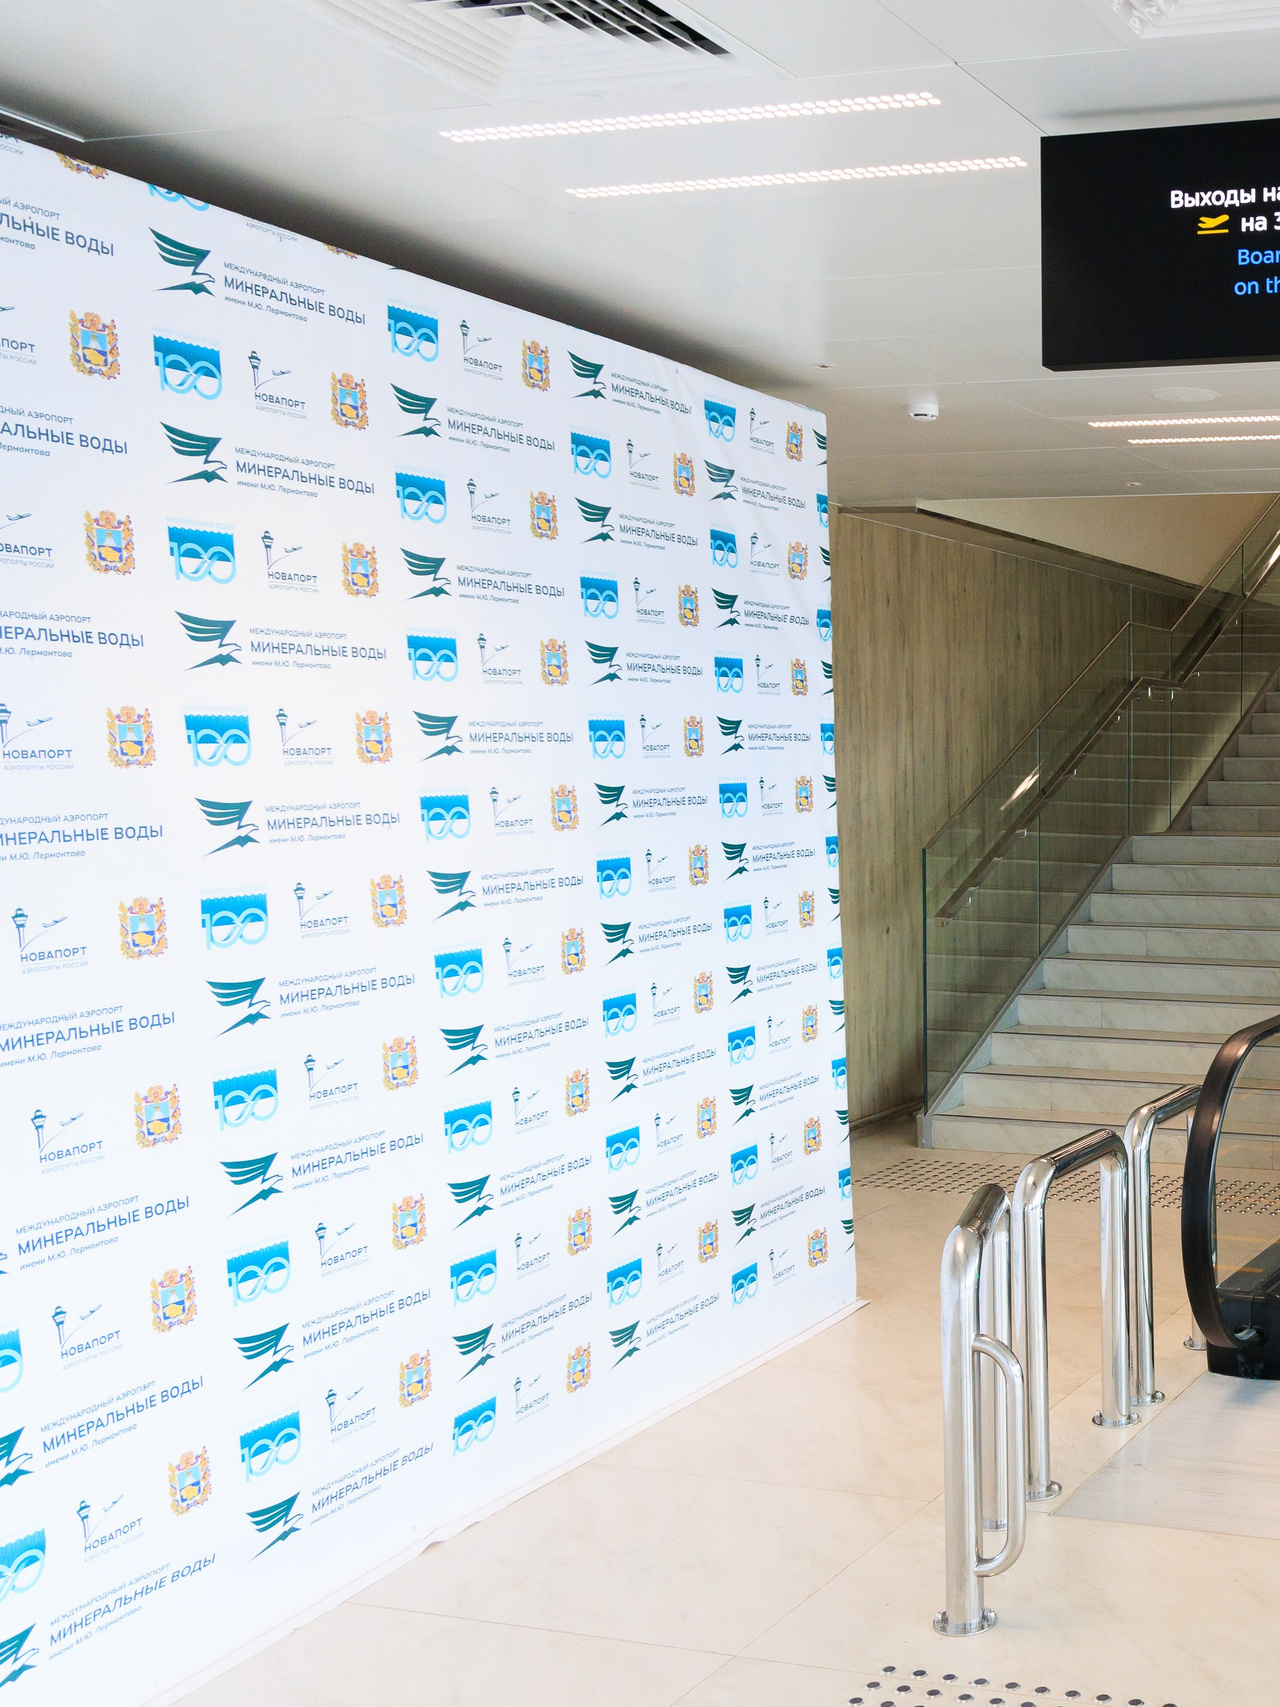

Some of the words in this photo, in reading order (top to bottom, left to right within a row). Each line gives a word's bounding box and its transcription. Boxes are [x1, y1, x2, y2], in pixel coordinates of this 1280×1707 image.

[1171, 187, 1256, 208] Выходы
[13, 200, 59, 220] АЭРОПОРТ
[1241, 215, 1268, 232] на
[64, 230, 114, 256] ВОДЫ
[222, 261, 288, 286] МЕЖДУНАРОДНЫЙ
[289, 280, 324, 296] АЭРОПОРТ
[1234, 280, 1260, 295] on
[223, 275, 324, 314] МИНЕРАЛЬНЫЕ
[328, 304, 365, 324] ВОДЫ
[463, 355, 502, 372] НОВАПОРТ
[254, 391, 305, 410] НОВАПОРТ
[611, 381, 669, 408] МИНЕРАЛЬНЫЕ
[670, 400, 690, 414] ВОДЫ
[27, 410, 73, 425] АЭРОПОРТ
[0, 420, 74, 446] АЛЬНЫЕ
[78, 434, 128, 454] ВОДЫ
[447, 418, 524, 444] МИНЕРАЛЬНЫЕ
[526, 435, 554, 451] ВОДЫ
[234, 446, 299, 464] МЕЖДУНАРОДНЫЙ
[301, 458, 334, 470] АЭРОПОРТ
[235, 460, 335, 488] МИНЕРАЛЬНЫЕ
[338, 477, 374, 494] ВОДЫ
[629, 470, 658, 483] НОВАПОРТ
[471, 513, 511, 526] НОВАПОРТ
[619, 523, 675, 542] МИНЕРАЛЬНЫЕ
[677, 534, 697, 547] ВОДЫ
[0, 543, 52, 558] ОВАПОРТ
[267, 570, 317, 583] НОВАПОРТ
[457, 576, 533, 594] МИНЕРАЛЬНЫЕ
[535, 584, 564, 598] ВОДЫ
[48, 613, 91, 623] АЭРОПОРТ
[636, 607, 664, 617] НОВАПОРТ
[0, 625, 93, 644] ЕРАЛЬНЫЕ
[97, 631, 144, 648] ВОДЫ
[249, 627, 312, 638] МЕЖДУНАРОДНЫЙ
[314, 631, 347, 640] АЭРОПОРТ
[19, 647, 71, 657] Лермонтова
[250, 640, 348, 657] МИНЕРАЛЬНЫЕ
[351, 646, 386, 661] ВОДЫ
[482, 667, 521, 676] НОВАПОРТ
[626, 662, 681, 674] МИНЕРАЛЬНЫЕ
[682, 665, 702, 676] ВОДЫ
[469, 732, 544, 742] МИНЕРАЛЬНЫЕ
[546, 732, 574, 743] ВОДЫ
[2, 749, 73, 758] НОВАПОРТ
[282, 747, 332, 755] НОВАПОРТ
[632, 796, 686, 808] МИНЕРАЛЬНЫЕ
[687, 795, 707, 806] ВОДЫ
[63, 812, 108, 822] АЭРОПОРТ
[266, 814, 362, 830] МИНЕРАЛЬНЫЕ
[365, 812, 400, 825] ВОДЫ
[494, 818, 533, 828] НОВАПОРТ
[0, 827, 109, 846] НЕРАЛЬНЫЕ
[114, 824, 162, 840] ВОДЫ
[32, 849, 86, 860] Лермонтова
[482, 877, 555, 896] МИНЕРАЛЬНЫЕ
[557, 875, 584, 887] ВОДЫ
[648, 875, 675, 885] НОВАПОРТ
[300, 915, 348, 929] НОВАПОРТ
[638, 925, 691, 943] МИНЕРАЛЬНЫЕ
[692, 921, 712, 933] ВОДЫ
[20, 946, 87, 962] НОВАПОРТ
[507, 965, 545, 978] НОВАПОРТ
[279, 978, 377, 1005] МИНЕРАЛЬНЫЕ
[380, 973, 415, 989] ВОДЫ
[79, 1004, 122, 1019] АЭРОПОРТ
[128, 1010, 175, 1031] ВОДЫ
[653, 1005, 680, 1018] НОВАПОРТ
[495, 1022, 563, 1048] МИНЕРАЛЬНЫЕ
[564, 1016, 588, 1031] ВОДЫ
[50, 1043, 101, 1059] Лермонтова
[642, 1053, 695, 1077] МИНЕРАЛЬНЫЕ
[696, 1047, 716, 1061] ВОДЫ
[309, 1082, 358, 1100] НОВАПОРТ
[515, 1110, 548, 1127] НОВАПОРТ
[39, 1140, 103, 1163] НОВАПОРТ
[656, 1133, 683, 1149] НОВАПОРТ
[291, 1141, 386, 1178] МИНЕРАЛЬНЫЕ
[389, 1131, 423, 1151] ВОДЫ
[500, 1163, 565, 1197] МИНЕРАЛЬНЫЕ
[567, 1154, 592, 1172] ВОДЫ
[646, 1178, 697, 1208] МИНЕРАЛЬНЫЕ
[698, 1169, 719, 1186] ВОДЫ
[15, 1204, 95, 1235] МЕЖДУНАРОДНЫЙ
[97, 1194, 138, 1213] АЭРОПОРТ
[17, 1208, 140, 1256] МИНЕРАЛЬНЫЕ
[144, 1194, 189, 1219] ВОДЫ
[19, 1257, 45, 1270] имени
[69, 1235, 118, 1255] Лермонтова
[320, 1245, 368, 1268] НОВАПОРТ
[516, 1251, 550, 1272] НОВАПОРТ
[658, 1259, 684, 1278] НОВАПОРТ
[302, 1301, 395, 1347] МИНЕРАЛЬНЫЕ
[397, 1287, 431, 1310] ВОДЫ
[501, 1303, 566, 1344] МИНЕРАЛЬНЫЕ
[567, 1291, 592, 1311] ВОДЫ
[645, 1302, 698, 1338] МИНЕРАЛЬНЫЕ
[699, 1291, 720, 1310] ВОДЫ
[60, 1329, 120, 1359] НОВАПОРТ
[40, 1394, 114, 1433] МЕЖДУНАРОДНЫЙ
[116, 1379, 155, 1402] АЭРОПОРТ
[42, 1393, 157, 1453] МИНЕРАЛЬНЫЕ
[160, 1374, 203, 1404] ВОДЫ
[515, 1392, 549, 1416] НОВАПОРТ
[330, 1406, 376, 1434] НОВАПОРТ
[91, 1422, 137, 1448] Лермонтова
[311, 1458, 399, 1514] МИНЕРАЛЬНЫЕ
[400, 1440, 433, 1467] ВОДЫ
[84, 1517, 142, 1553] НОВАПОРТ
[49, 1574, 167, 1644] МИНЕРАЛЬНЫЕ
[169, 1549, 217, 1584] ВОДЫ
